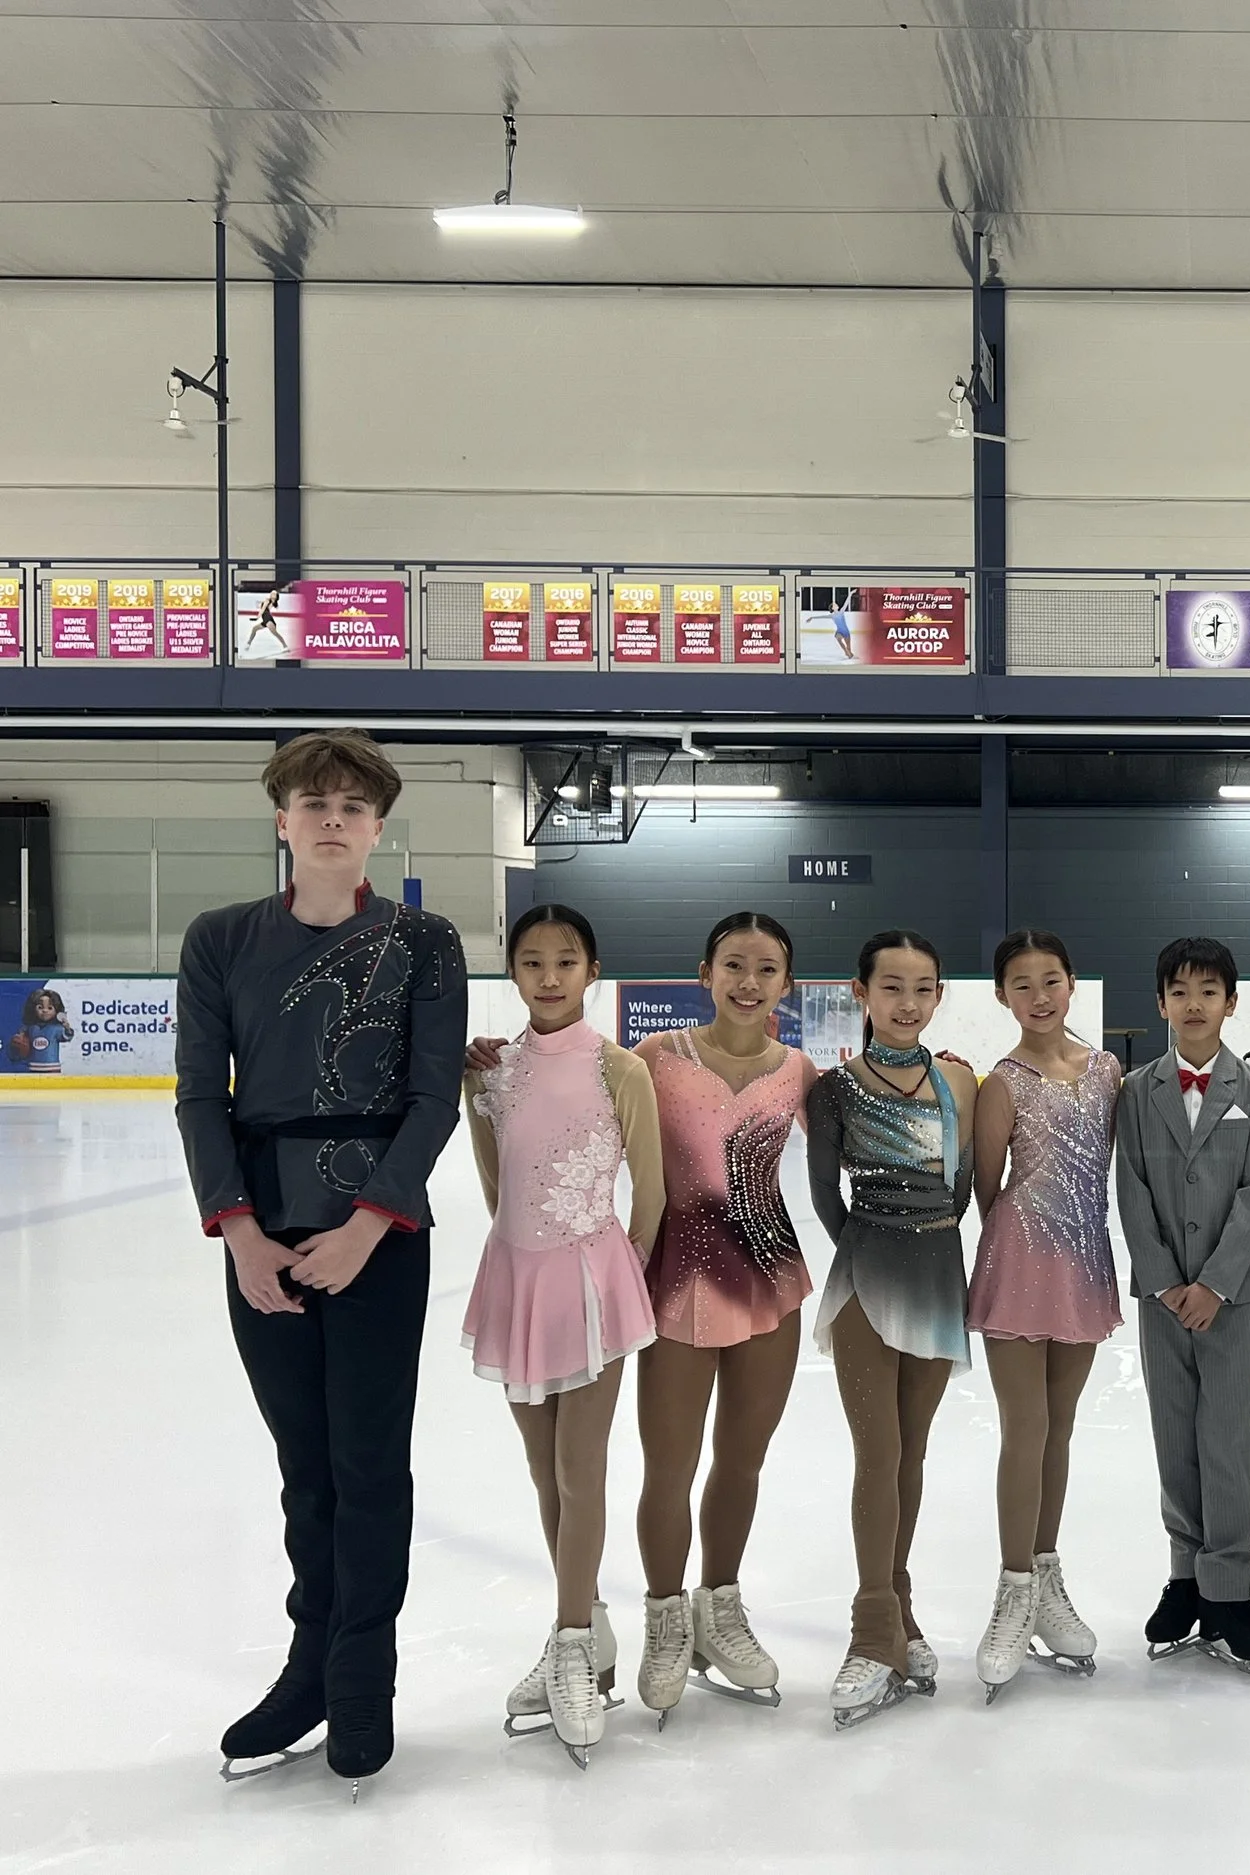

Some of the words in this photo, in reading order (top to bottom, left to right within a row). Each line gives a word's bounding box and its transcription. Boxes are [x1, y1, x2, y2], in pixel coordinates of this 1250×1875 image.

[58, 584, 92, 596] 2019
[113, 585, 148, 597] 2018
[169, 585, 203, 597] 2016
[316, 587, 358, 595] Thornhill
[359, 587, 387, 597] Figure
[490, 588, 523, 600] 2017
[551, 588, 585, 600] 2016
[620, 589, 654, 601] 2016
[316, 595, 348, 604] Skating
[350, 595, 371, 603] Club
[680, 590, 714, 602] 2016
[739, 591, 773, 602] 2015
[883, 593, 924, 601] Thornhill
[925, 593, 953, 603] Figure
[883, 602, 915, 611] Skating
[329, 621, 375, 634] ERICA
[490, 621, 522, 629] CANADIAN
[680, 623, 713, 631] CANADIAN
[59, 634, 91, 642] NATIONAL
[685, 631, 710, 639] WOMEN
[751, 631, 762, 639] ALL
[887, 628, 950, 640] AURORA
[305, 635, 400, 648] FALLAVOLLITA
[495, 637, 518, 645] JUNIOR
[686, 639, 709, 647] NOVICE
[743, 639, 771, 647] ONTARIO
[489, 645, 523, 653] CHAMPION
[680, 647, 715, 655] CHAMPION
[740, 647, 774, 655] CHAMPION
[893, 641, 943, 653] COTOP
[803, 861, 849, 876] HOME
[82, 1000, 169, 1015] Dedicated
[628, 1001, 673, 1013] Where
[628, 1015, 699, 1027] Classroom
[81, 1021, 99, 1034] to
[81, 1042, 134, 1056] game.
[808, 1047, 838, 1056] YORK
